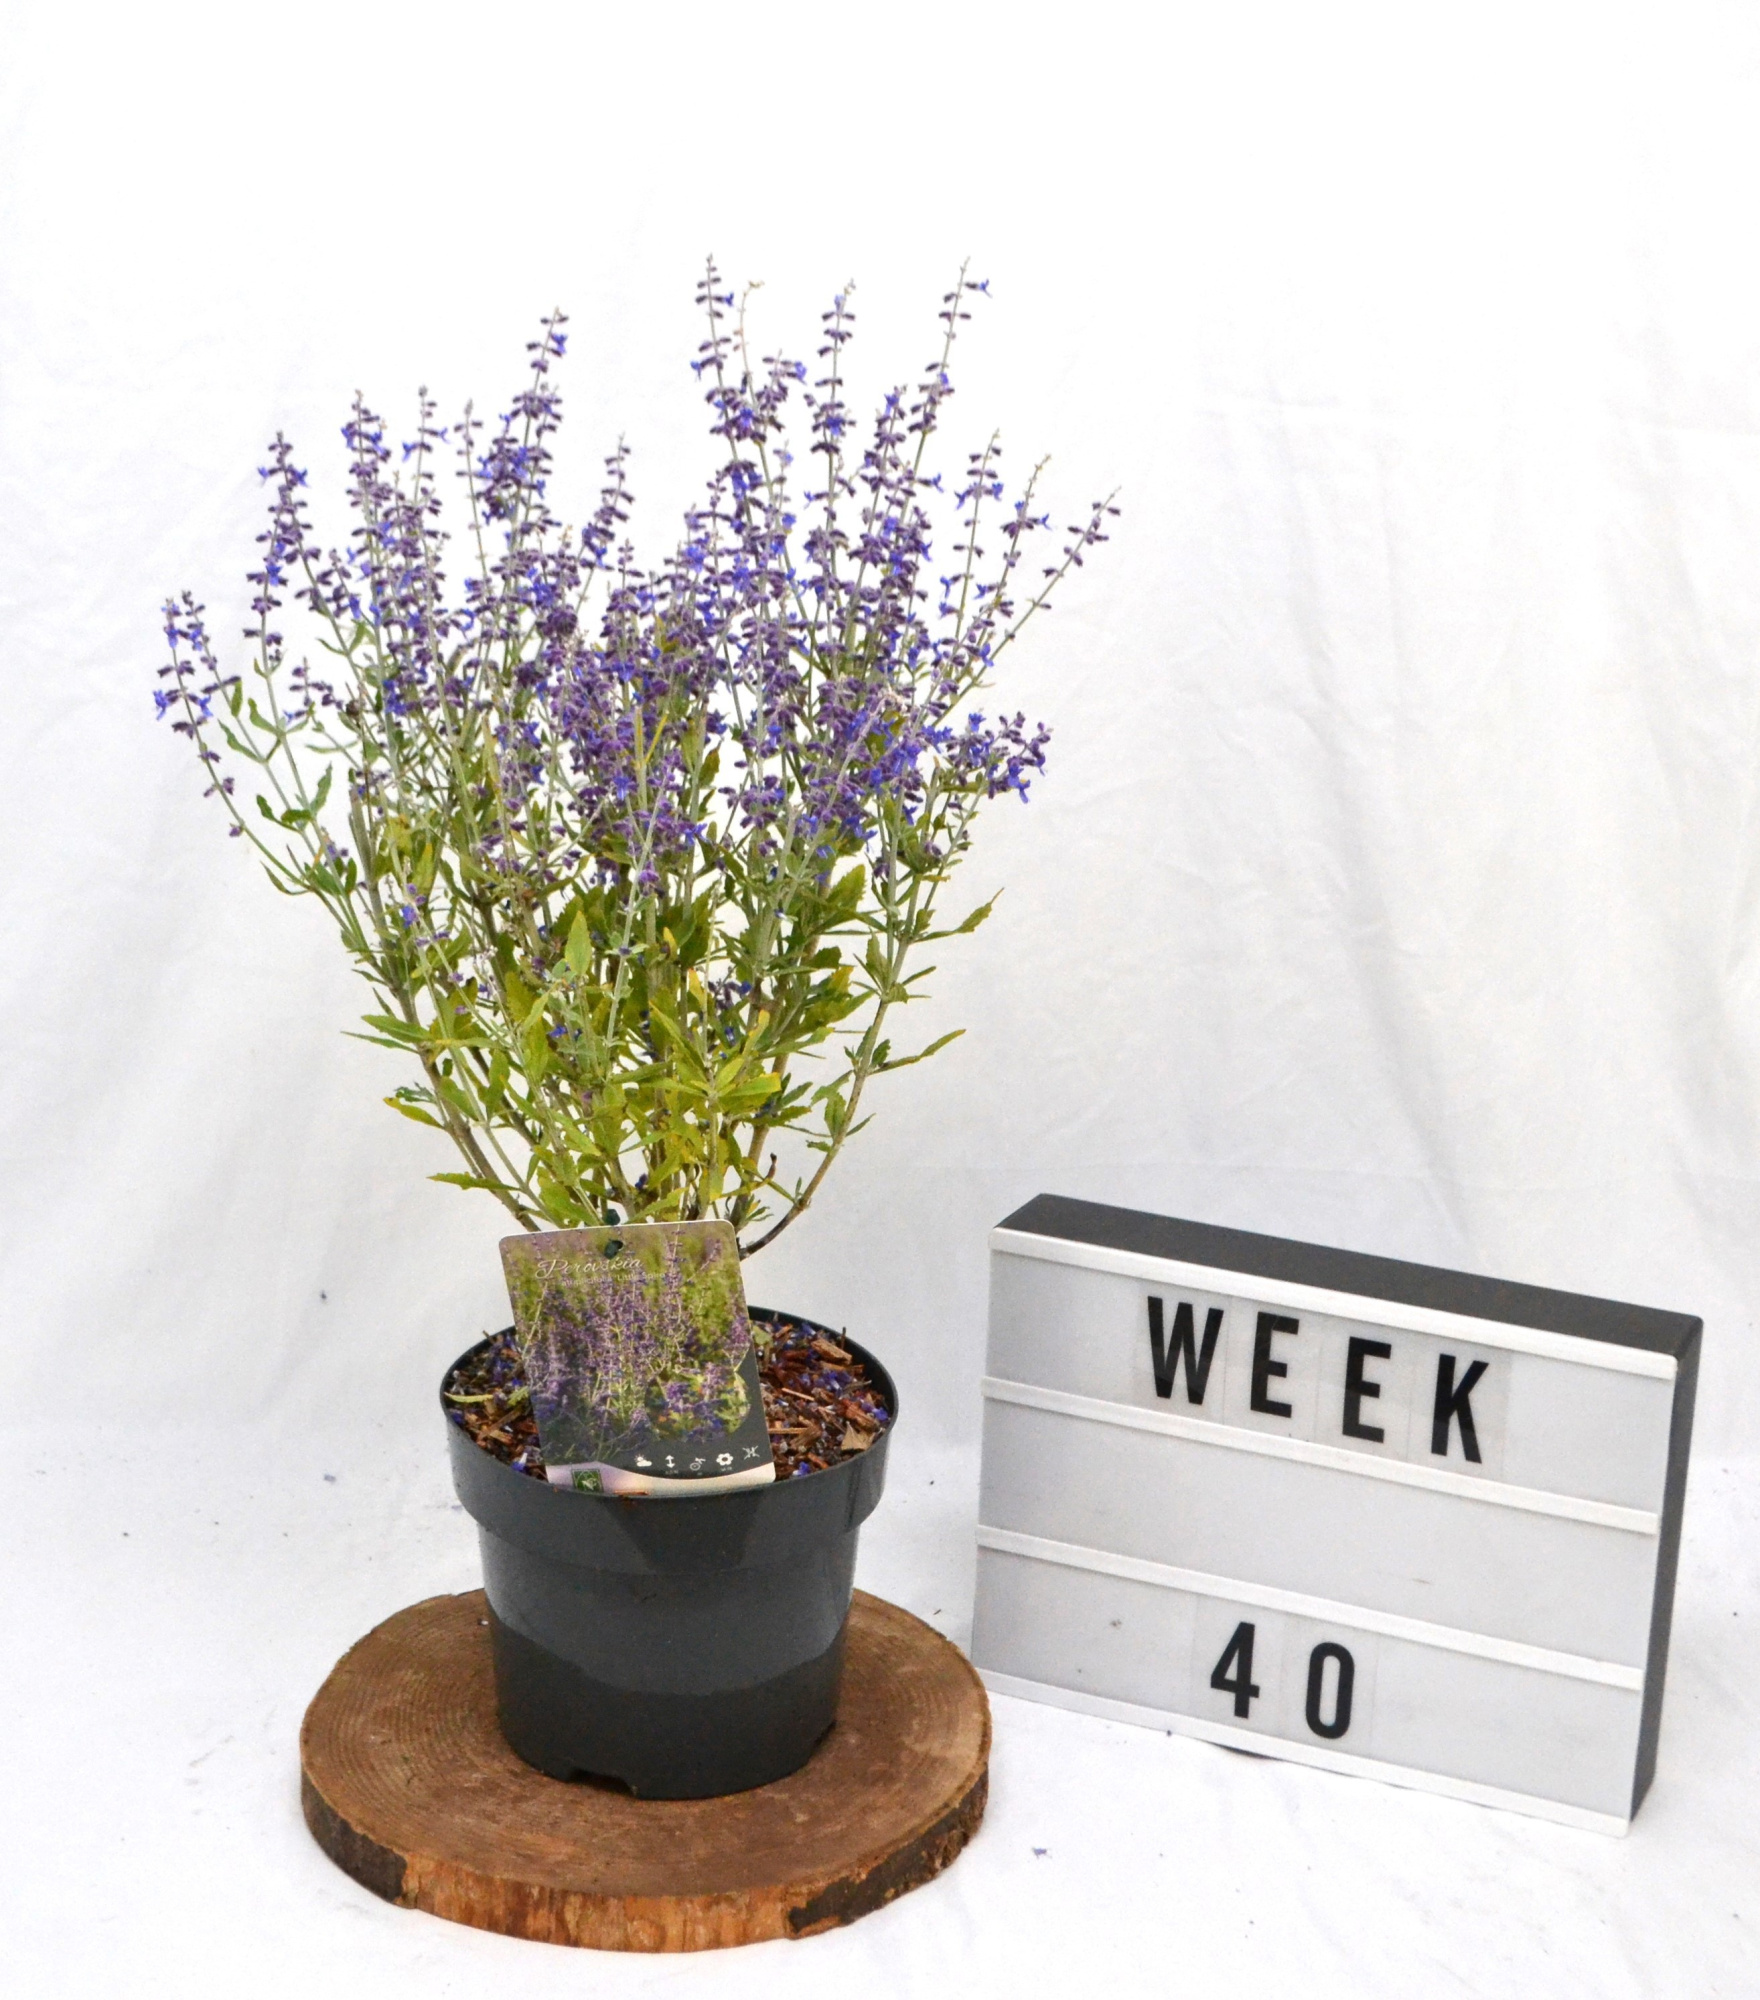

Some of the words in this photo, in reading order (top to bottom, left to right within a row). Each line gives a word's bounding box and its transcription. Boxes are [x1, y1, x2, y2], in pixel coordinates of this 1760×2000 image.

[535, 1256, 643, 1279] Perovskia
[1148, 1296, 1489, 1464] WEEK
[1210, 1621, 1355, 1739] 40
